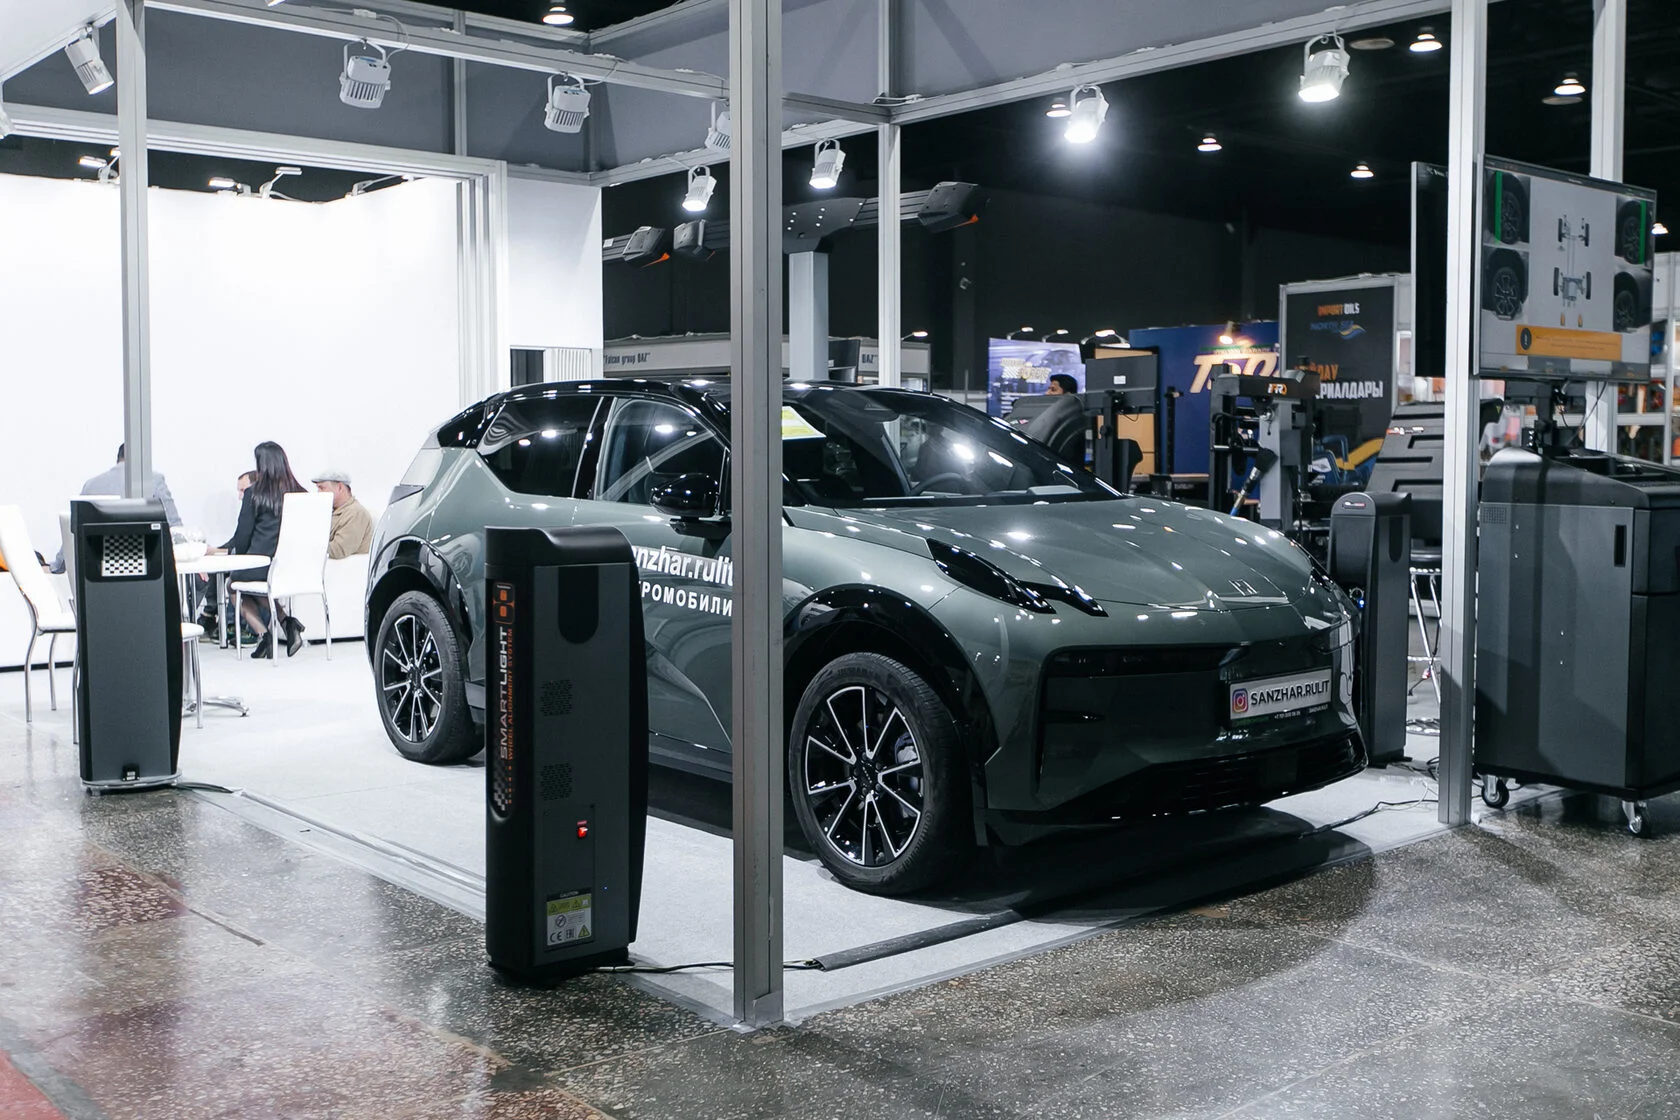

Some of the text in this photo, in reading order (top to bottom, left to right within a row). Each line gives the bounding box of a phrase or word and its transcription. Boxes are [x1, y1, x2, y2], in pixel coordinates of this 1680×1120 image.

[1344, 303, 1360, 314] OILS
[1315, 380, 1384, 400] РИАЛДАРЫ
[632, 545, 734, 587] nzhar.rulit
[638, 580, 733, 617] РОМОБИЛИ
[499, 626, 508, 761] SMARTLIGHT
[1251, 680, 1330, 706] SANZHAR.RULIT
